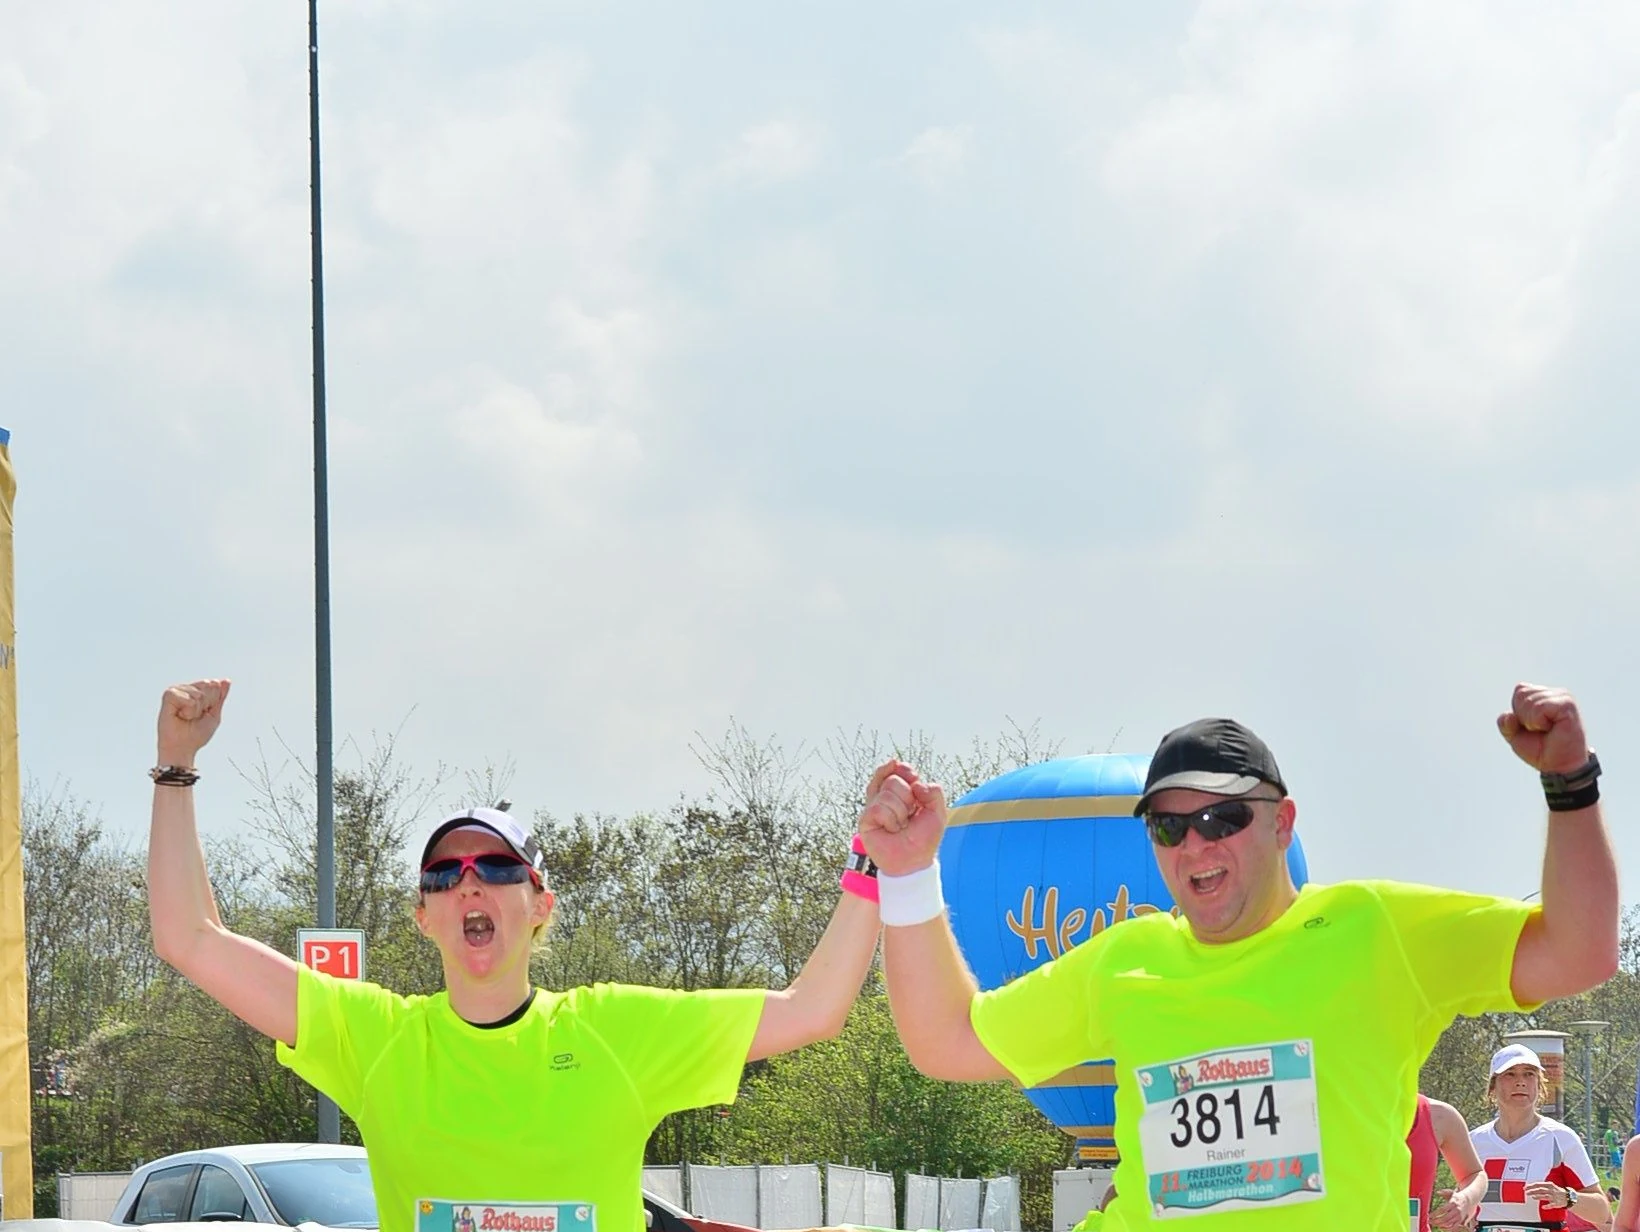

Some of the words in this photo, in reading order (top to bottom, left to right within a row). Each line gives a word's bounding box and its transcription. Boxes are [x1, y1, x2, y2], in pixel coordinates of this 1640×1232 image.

[311, 946, 330, 970] P
[338, 946, 350, 975] 1
[1197, 1057, 1270, 1082] Rothaus
[1170, 1084, 1280, 1148] 3814
[1207, 1148, 1246, 1161] Rainer
[1187, 1164, 1243, 1180] FREIBURG
[1246, 1156, 1303, 1184] 2014
[1188, 1176, 1244, 1190] MARATHON
[1188, 1183, 1274, 1203] Halbmarathon
